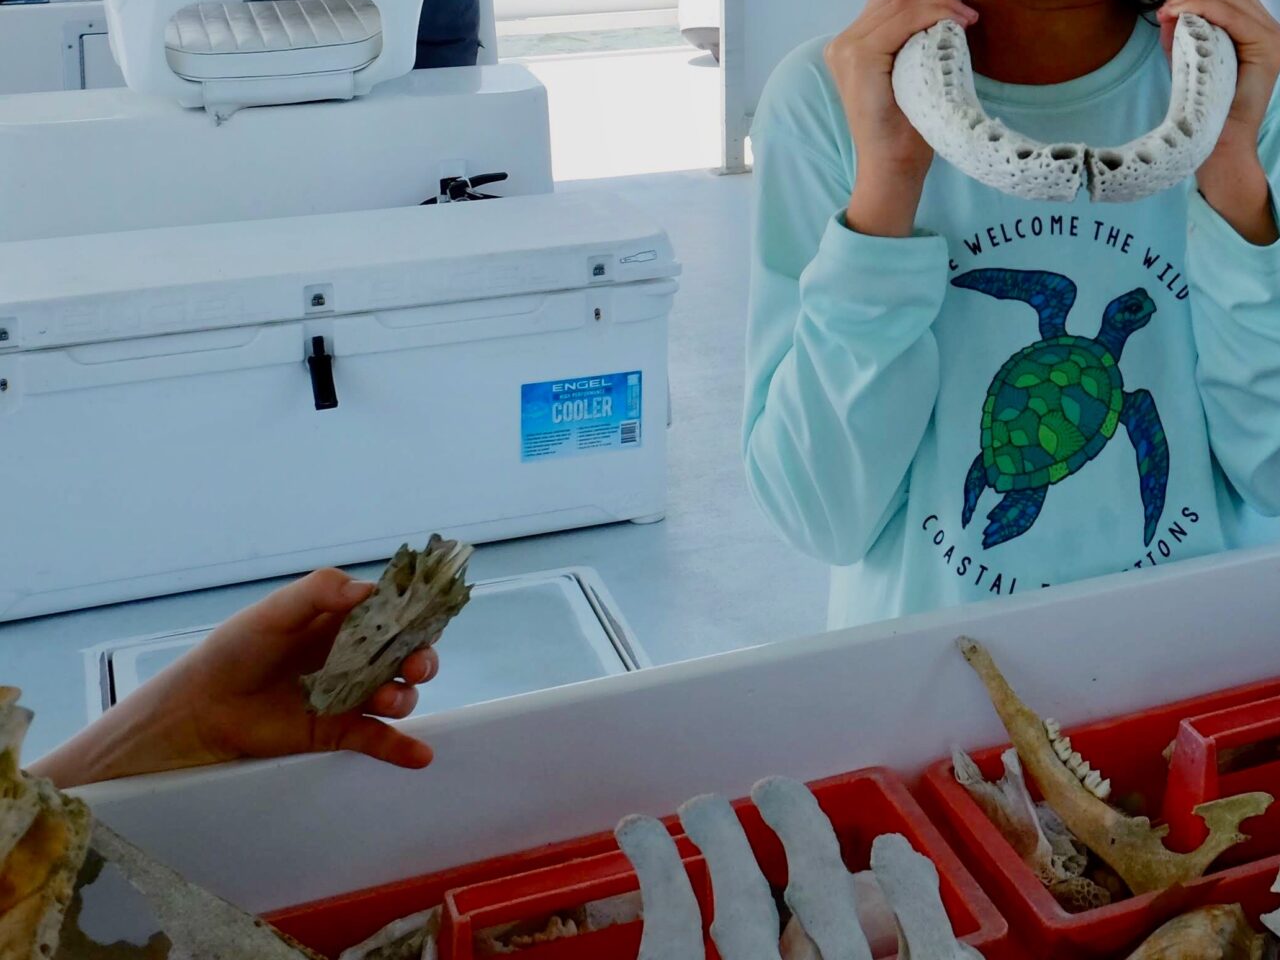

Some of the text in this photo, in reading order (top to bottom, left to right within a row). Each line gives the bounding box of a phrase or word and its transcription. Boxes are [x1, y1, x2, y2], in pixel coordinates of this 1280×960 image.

[964, 215, 1190, 301] WELCOME THE WILD
[552, 378, 612, 392] ENGEL
[551, 395, 613, 424] COOLER
